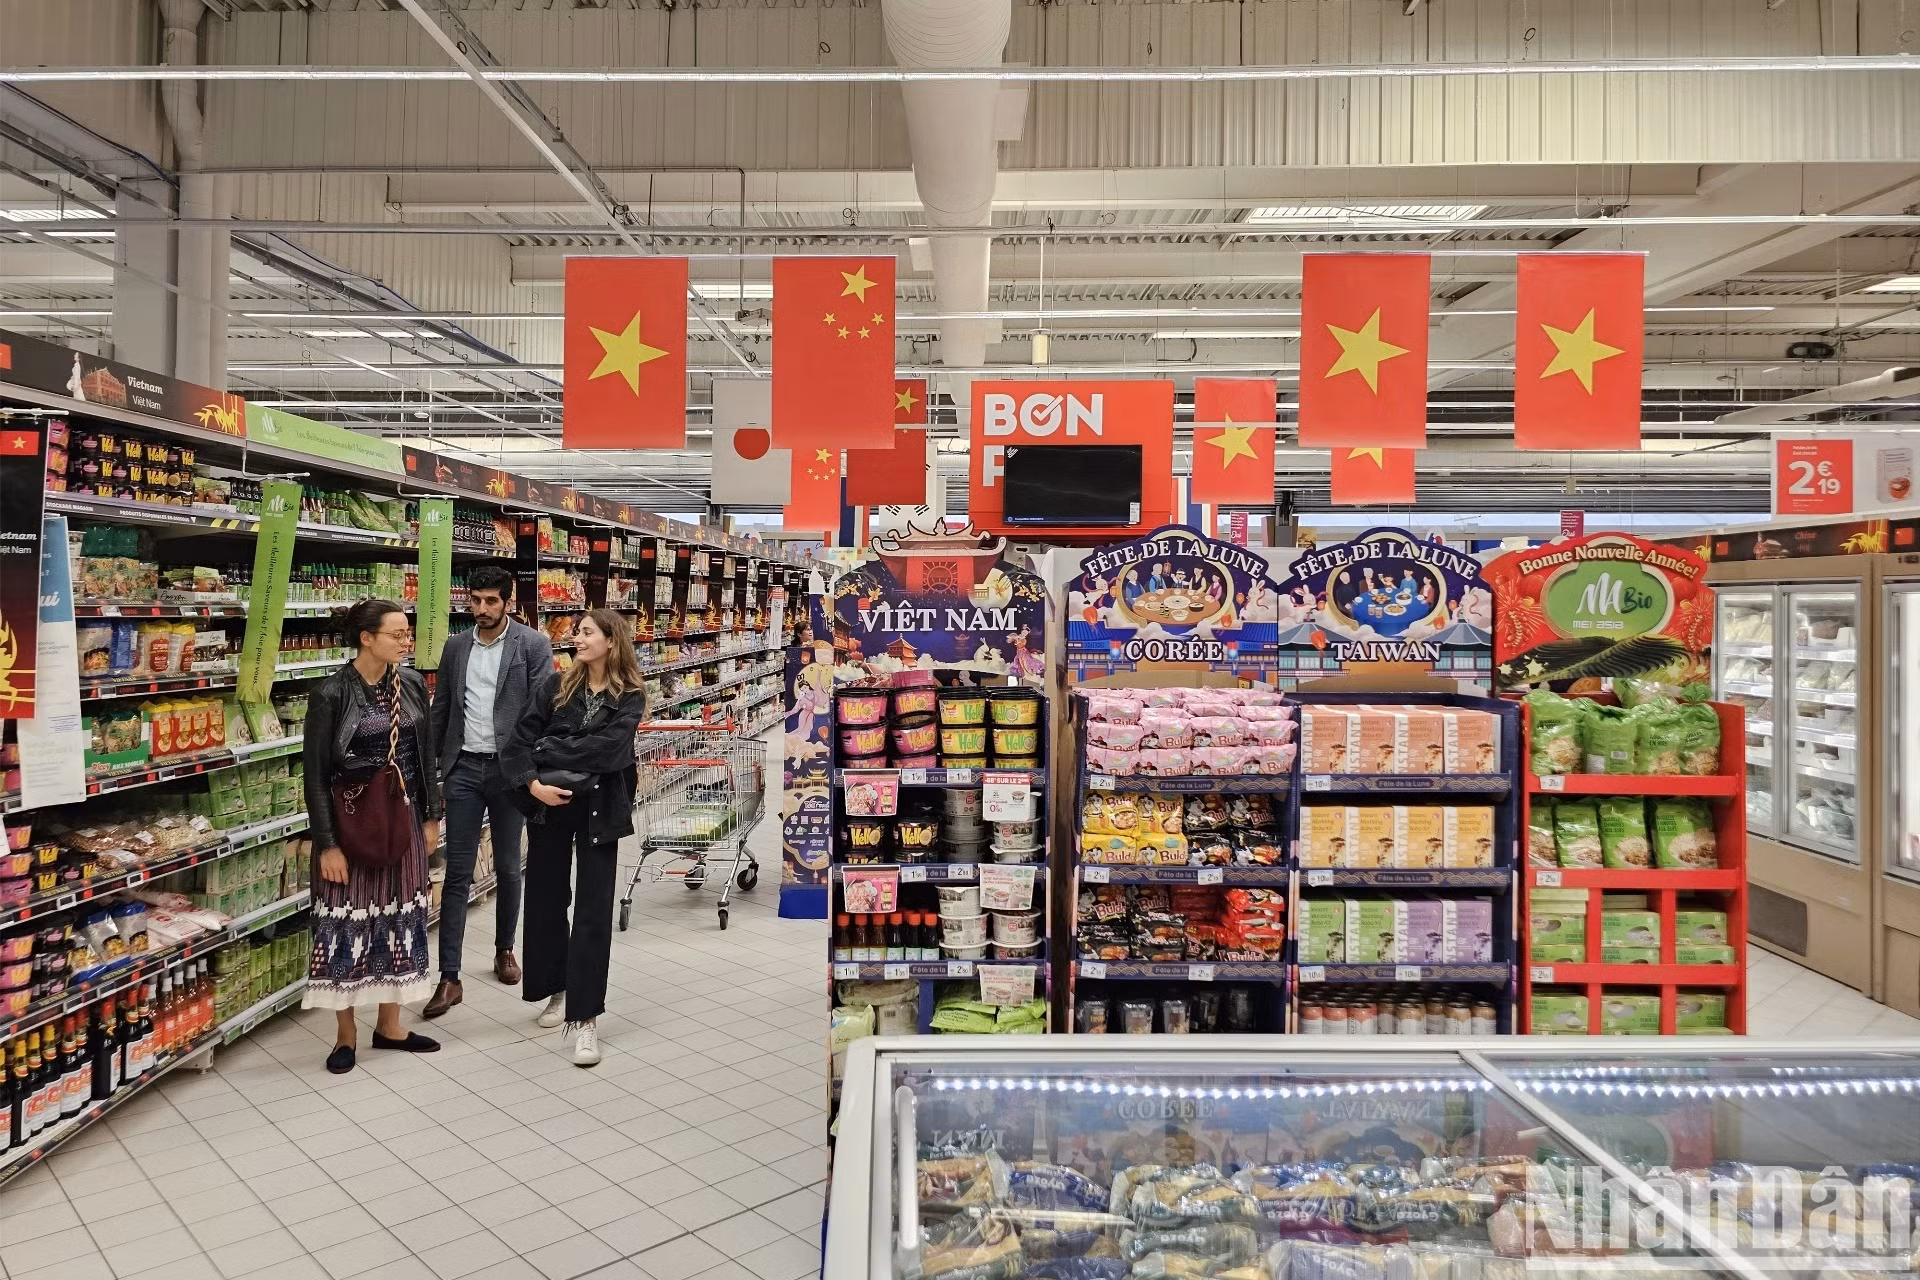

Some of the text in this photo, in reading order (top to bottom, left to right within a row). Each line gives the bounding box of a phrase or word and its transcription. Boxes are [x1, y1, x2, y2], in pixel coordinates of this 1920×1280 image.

[127, 376, 164, 395] Vietnam
[132, 395, 161, 411] Việt Nam
[983, 393, 1104, 436] BON
[11, 546, 32, 554] Nam
[1085, 539, 1264, 579] FÊTE DE LA LUNE
[1295, 542, 1478, 581] FÊTE DE LA LUNE
[1518, 545, 1700, 578] Bonne Nouvelle Année!
[262, 584, 273, 614] Saveurs
[1622, 586, 1653, 614] Bio
[260, 615, 269, 625] de
[858, 600, 1018, 632] VIÊT NAM
[254, 648, 262, 665] pour
[1126, 635, 1224, 661] CORÉE
[1330, 642, 1442, 661] TAIWAN
[930, 773, 946, 782] de la
[1160, 781, 1176, 789] Fête
[1378, 780, 1430, 788] Fête de la Lune
[1158, 870, 1192, 878] Fête de la
[1377, 874, 1430, 882] Fête de la Lune
[912, 966, 946, 974] Fête de la
[1155, 966, 1170, 974] Fête
[1171, 966, 1180, 974] de
